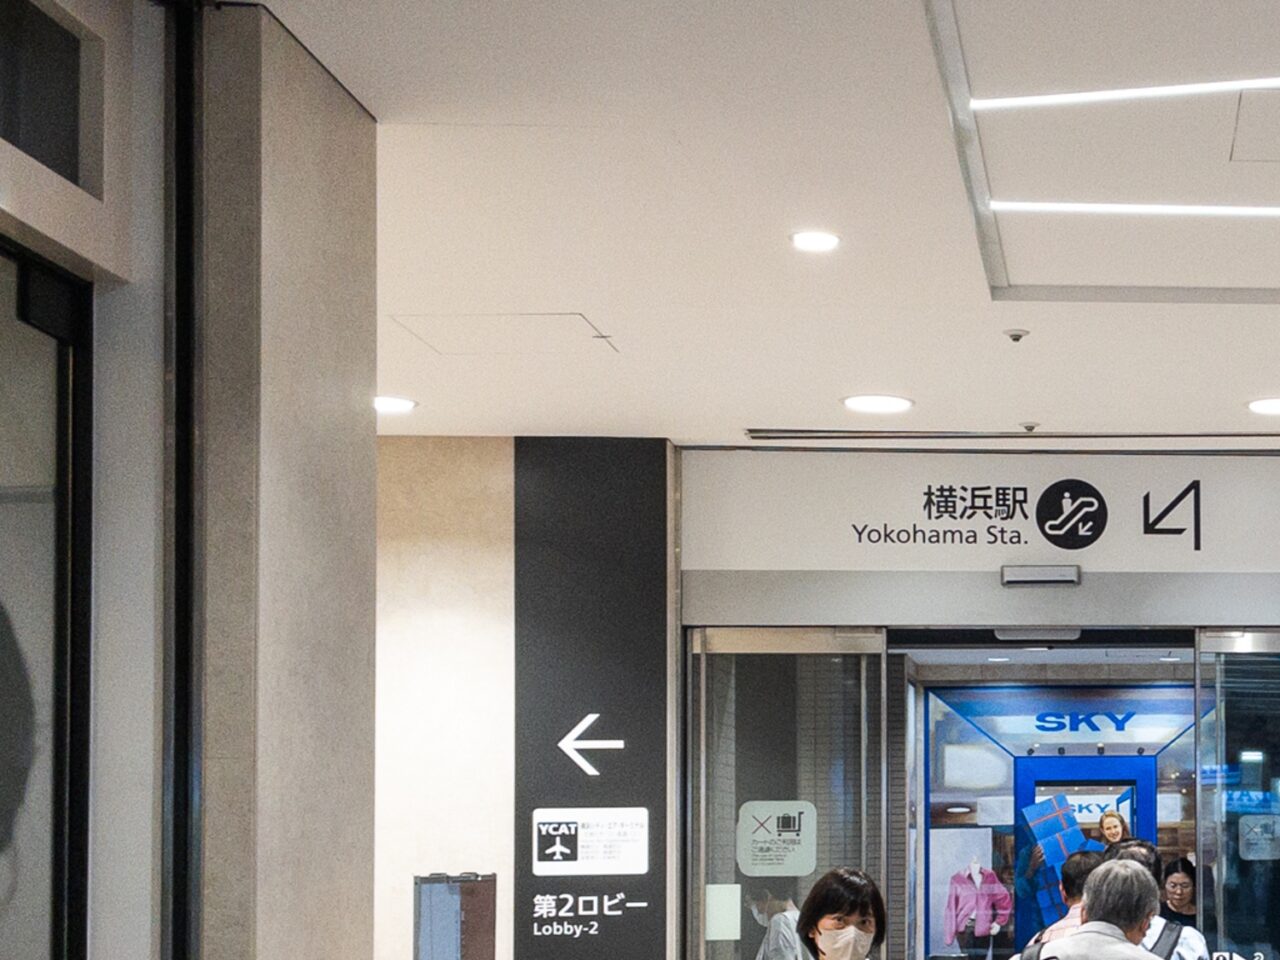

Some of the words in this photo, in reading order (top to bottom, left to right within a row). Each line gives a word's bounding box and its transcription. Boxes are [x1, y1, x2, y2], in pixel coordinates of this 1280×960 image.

[923, 485, 1028, 521] 横浜駅
[852, 524, 977, 545] Yokohama
[986, 524, 1028, 545] Sta.
[1035, 711, 1136, 732] SKY
[539, 823, 577, 836] YCAT
[533, 893, 648, 918] 第2ロビー
[533, 921, 598, 938] Lobby-2
